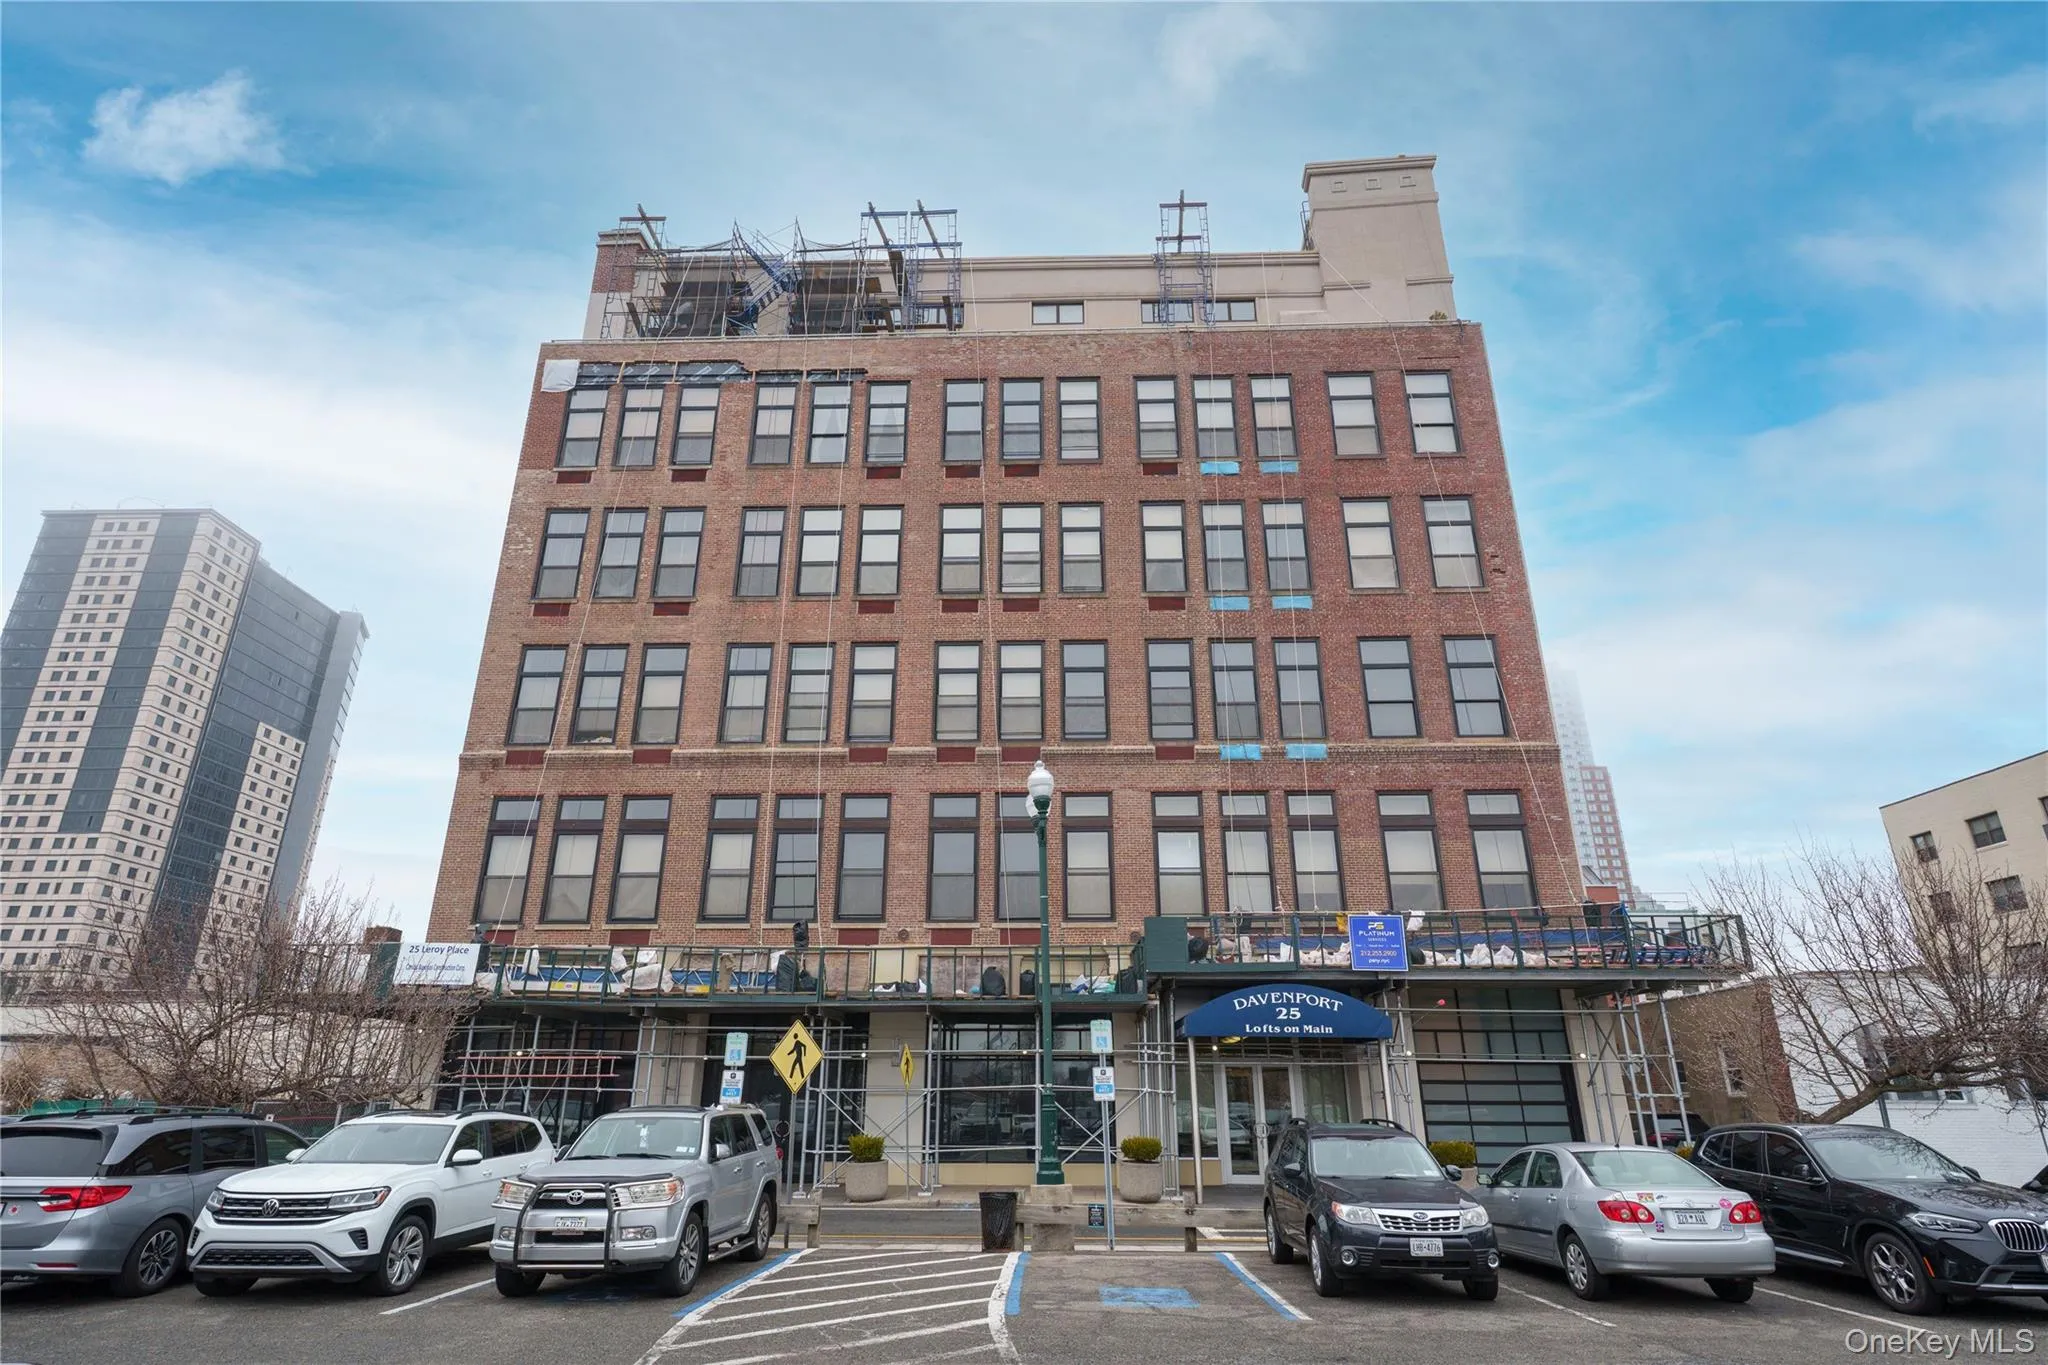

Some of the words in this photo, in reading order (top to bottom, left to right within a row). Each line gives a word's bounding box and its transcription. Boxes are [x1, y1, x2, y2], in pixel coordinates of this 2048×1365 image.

[409, 945, 420, 953] 25
[421, 945, 446, 955] Leroy
[446, 945, 470, 954] Place
[1233, 992, 1343, 1012] DAVENPORT
[1276, 1007, 1301, 1020] 25
[1245, 1024, 1280, 1033] Lofts
[1284, 1025, 1300, 1033] on
[1303, 1024, 1333, 1034] Main
